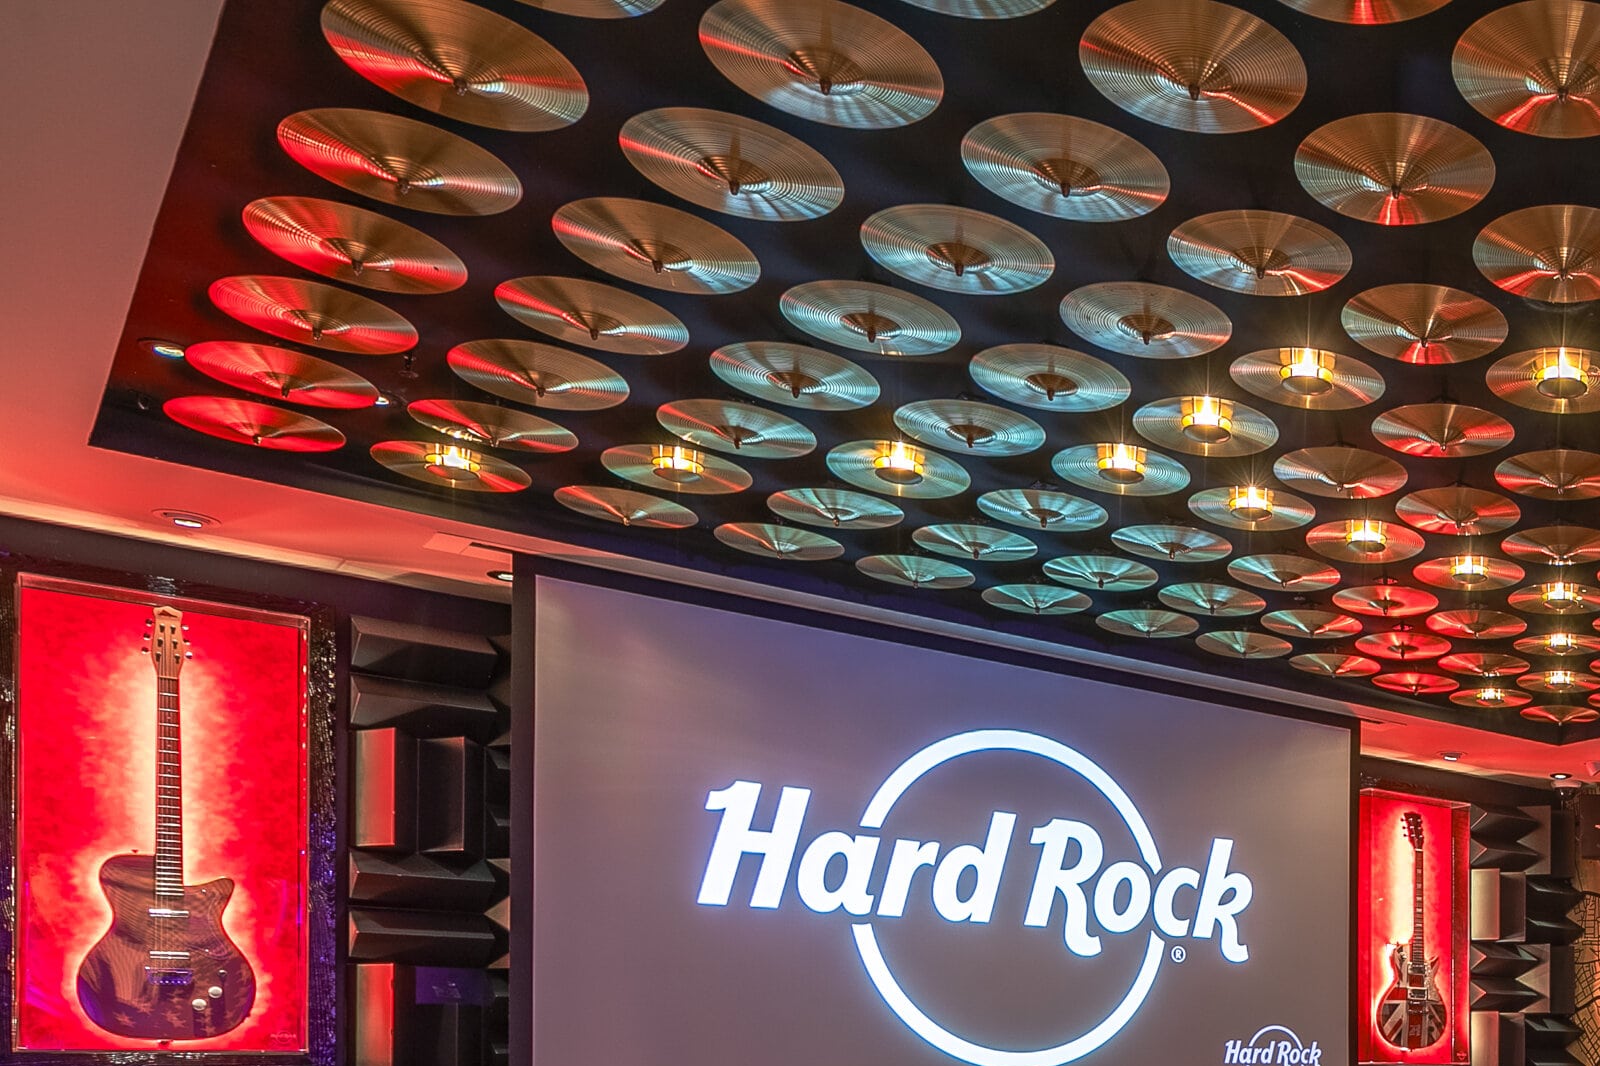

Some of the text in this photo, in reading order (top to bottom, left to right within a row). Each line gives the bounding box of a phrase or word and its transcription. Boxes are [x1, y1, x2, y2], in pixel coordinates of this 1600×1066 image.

[697, 780, 1254, 964] Hard Rock
[1224, 1040, 1276, 1064] Hard
